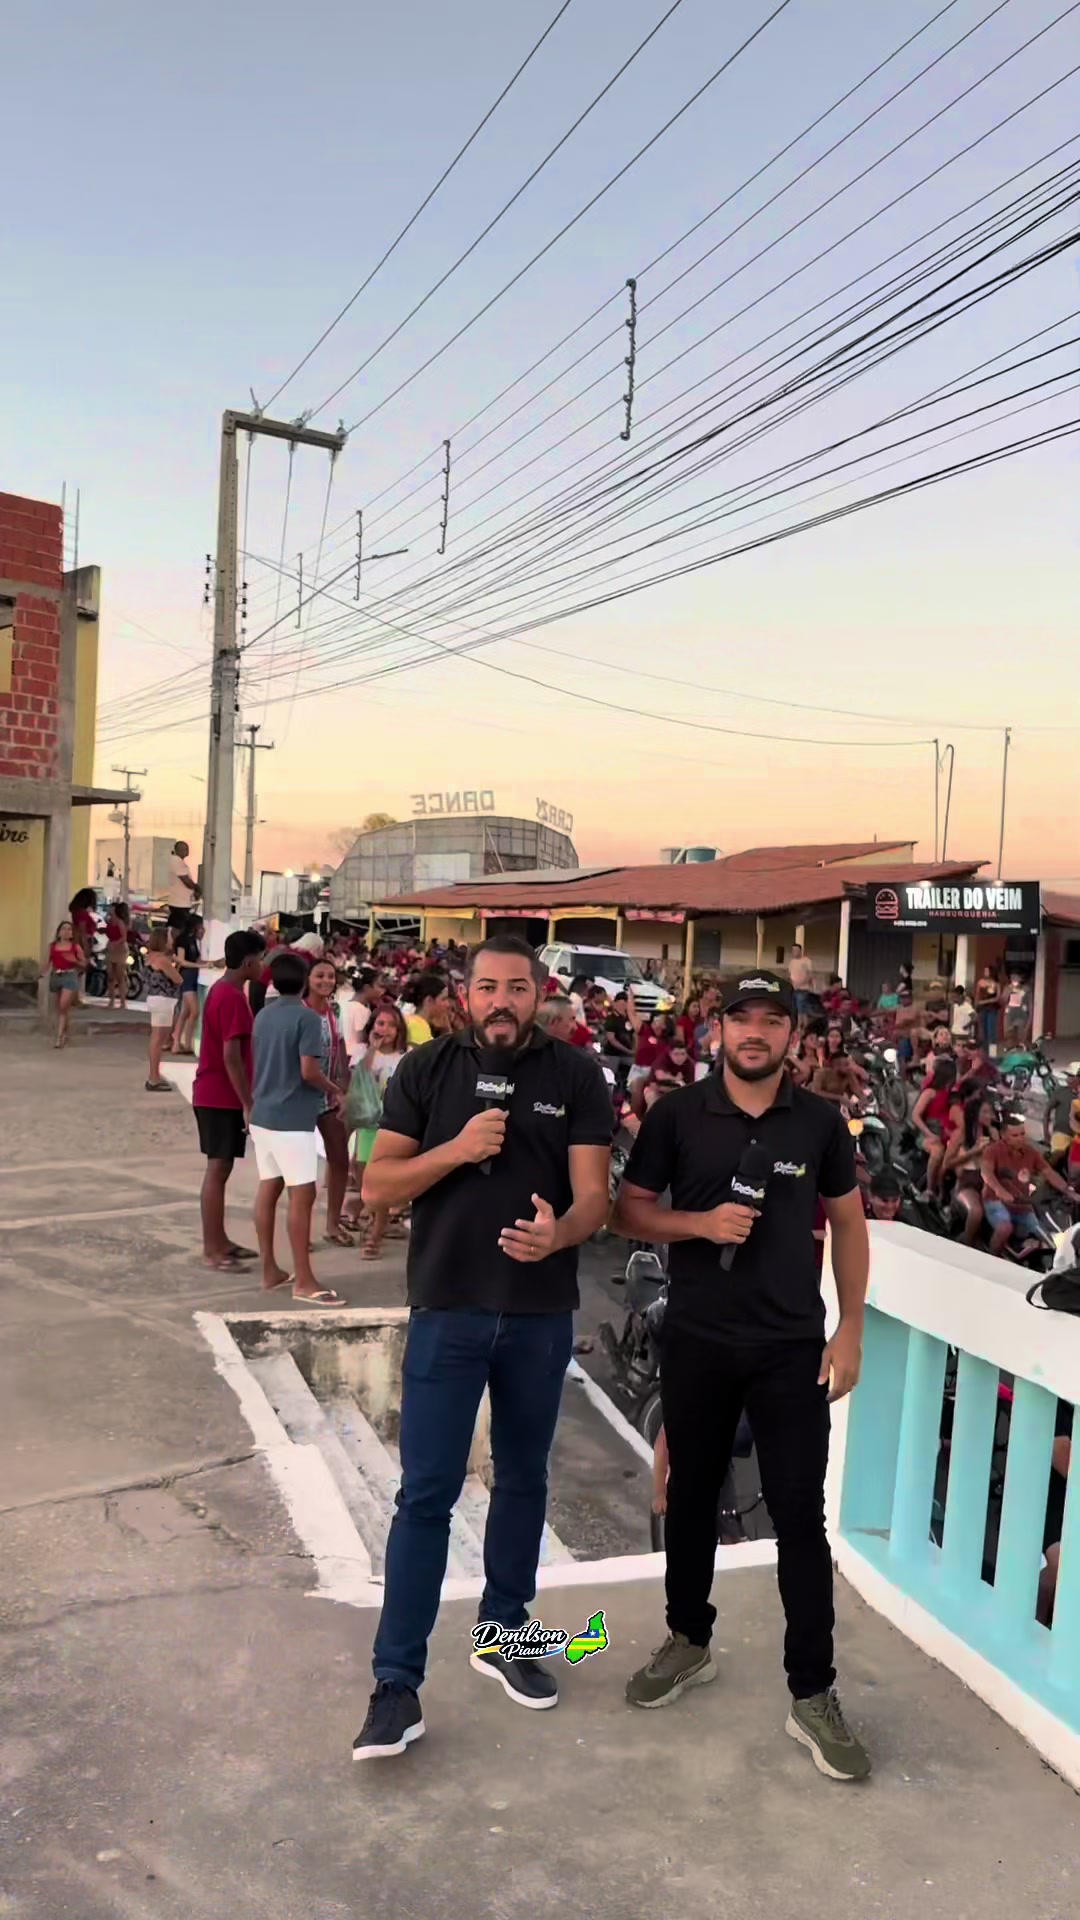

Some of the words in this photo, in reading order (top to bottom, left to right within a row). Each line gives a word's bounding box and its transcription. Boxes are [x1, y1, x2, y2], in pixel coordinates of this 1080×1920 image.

[905, 887, 961, 910] TRAILER
[963, 887, 982, 910] DO
[985, 888, 1022, 911] VEIM
[928, 910, 997, 919] HAMBURGUERIA
